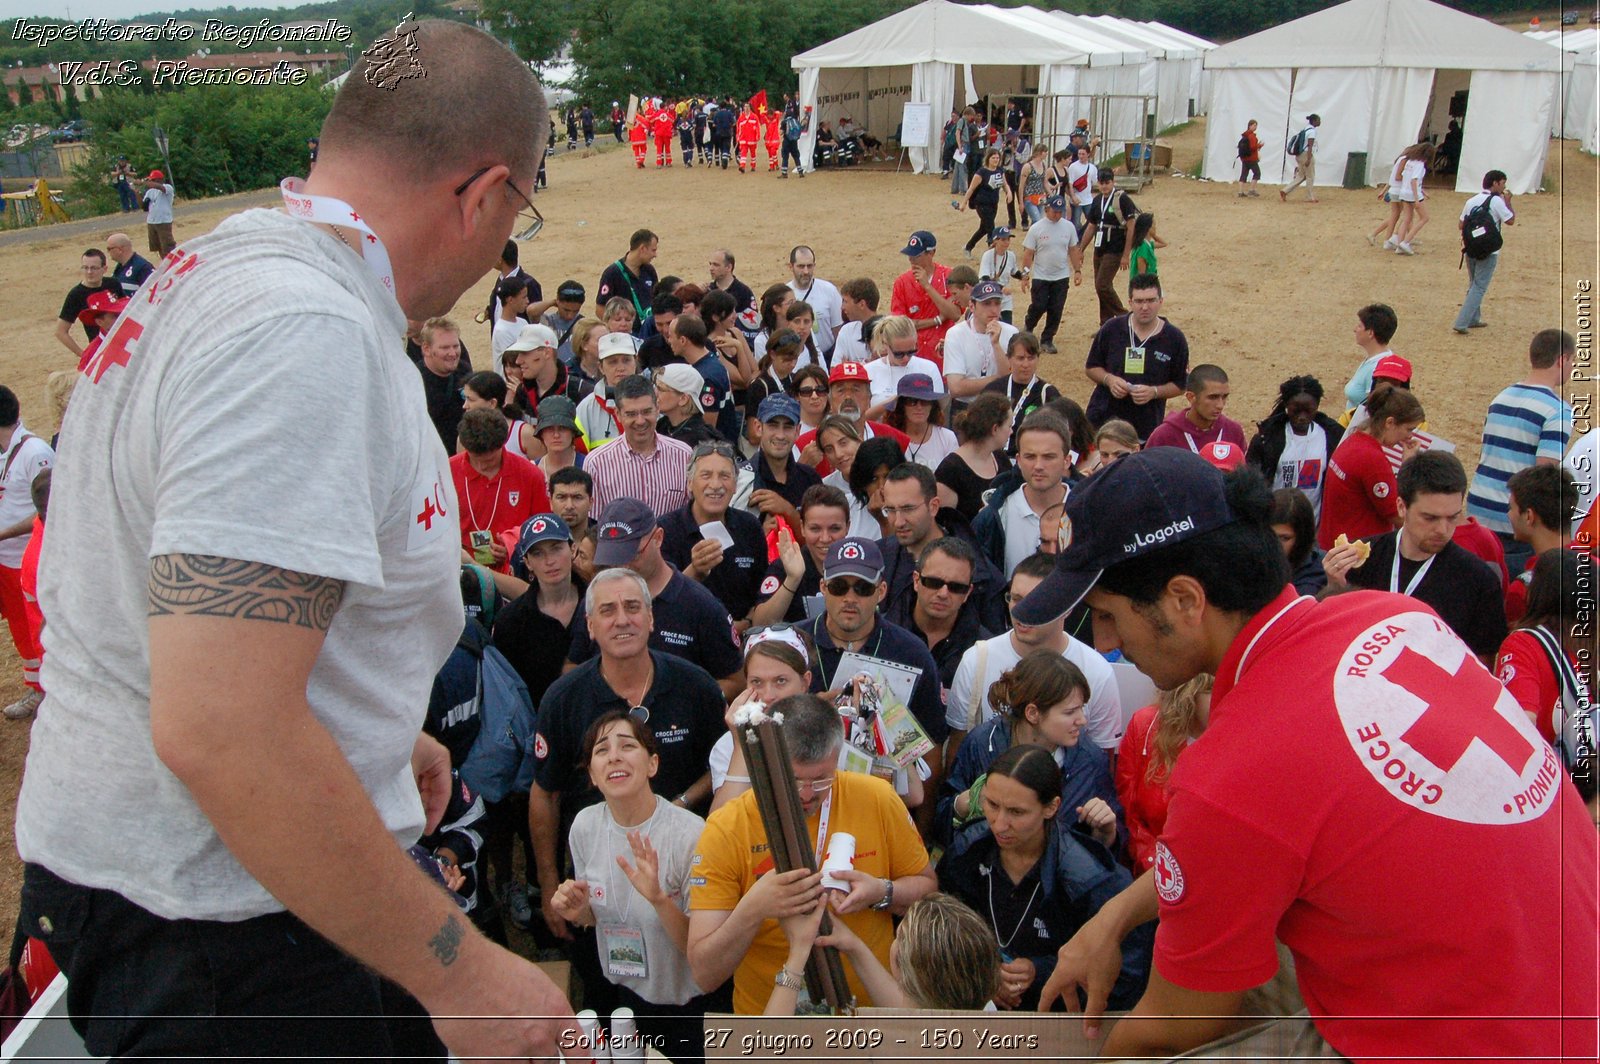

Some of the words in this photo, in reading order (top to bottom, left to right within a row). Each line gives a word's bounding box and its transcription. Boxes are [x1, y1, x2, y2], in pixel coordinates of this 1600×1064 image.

[1124, 542, 1137, 553] by
[1135, 516, 1194, 547] Logotel
[660, 631, 678, 639] CROCE
[677, 634, 694, 642] ROSSA
[665, 637, 688, 646] ITALIANA
[1347, 622, 1407, 677] ROSSA
[1357, 722, 1444, 805] CROCE
